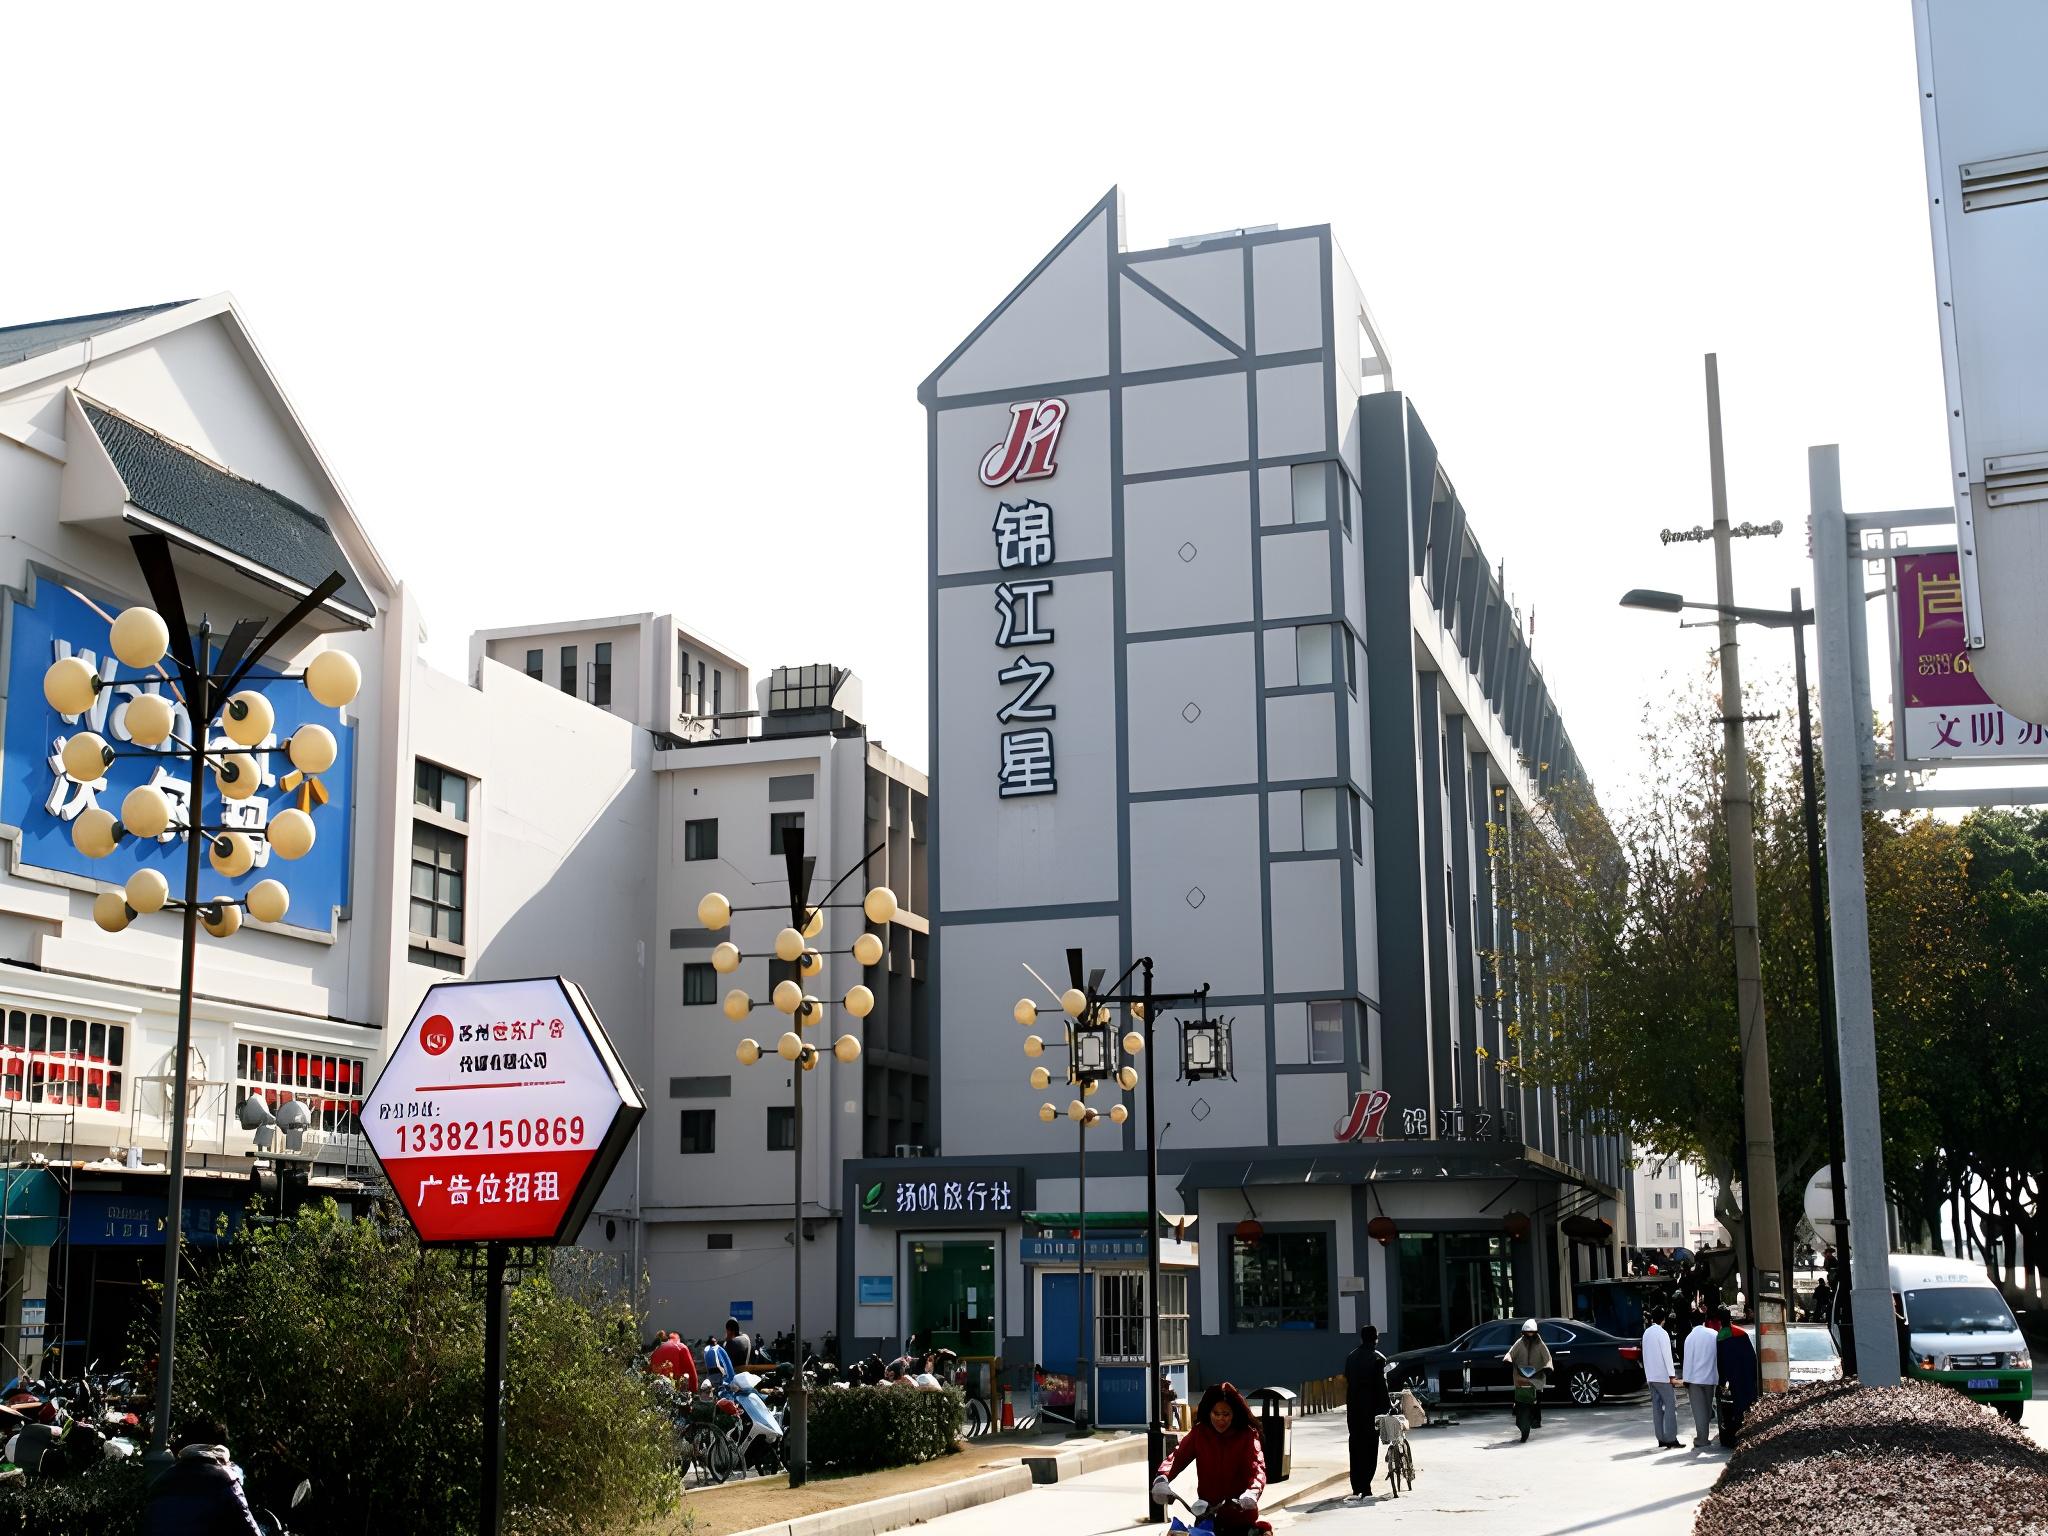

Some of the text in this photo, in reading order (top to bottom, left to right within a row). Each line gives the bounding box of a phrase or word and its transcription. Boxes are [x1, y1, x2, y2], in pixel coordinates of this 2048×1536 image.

[993, 498, 1057, 799] 锦江之星
[396, 1116, 584, 1152] 13382150869
[417, 1171, 561, 1208] 广告位招租
[897, 1181, 1012, 1212] 扬帆旅行社
